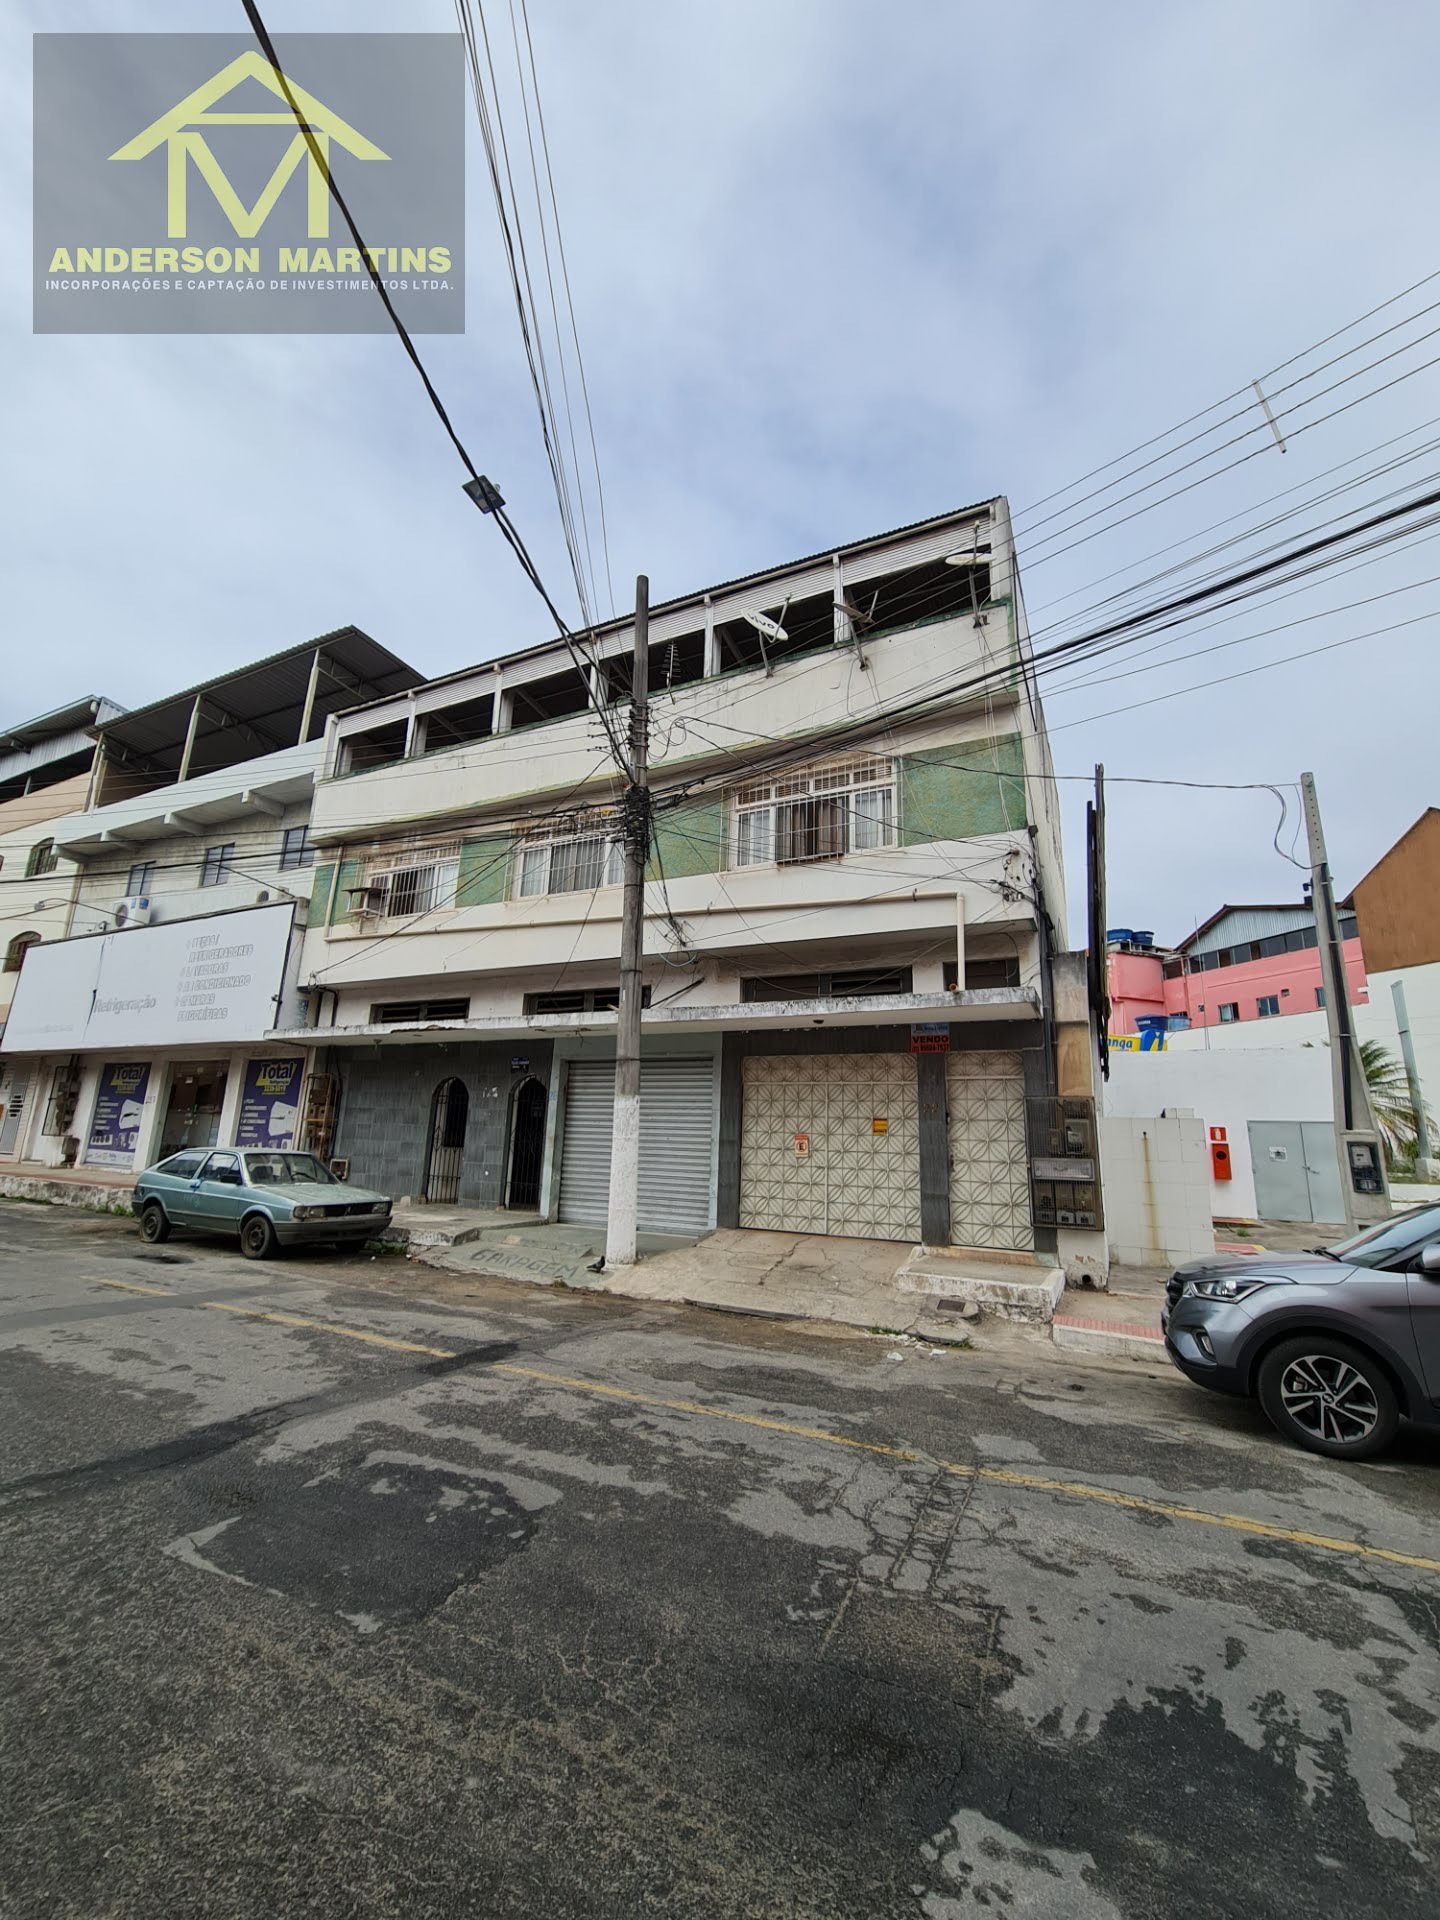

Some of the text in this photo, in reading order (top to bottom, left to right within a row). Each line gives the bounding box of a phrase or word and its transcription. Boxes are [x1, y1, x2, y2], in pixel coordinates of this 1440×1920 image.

[747, 613, 775, 629] vivo
[94, 995, 156, 1014] Refrigeração
[912, 1035, 949, 1043] VENDO
[115, 1065, 142, 1080] Total
[262, 1062, 293, 1079] Total
[470, 1249, 579, 1278] GARAGEM
